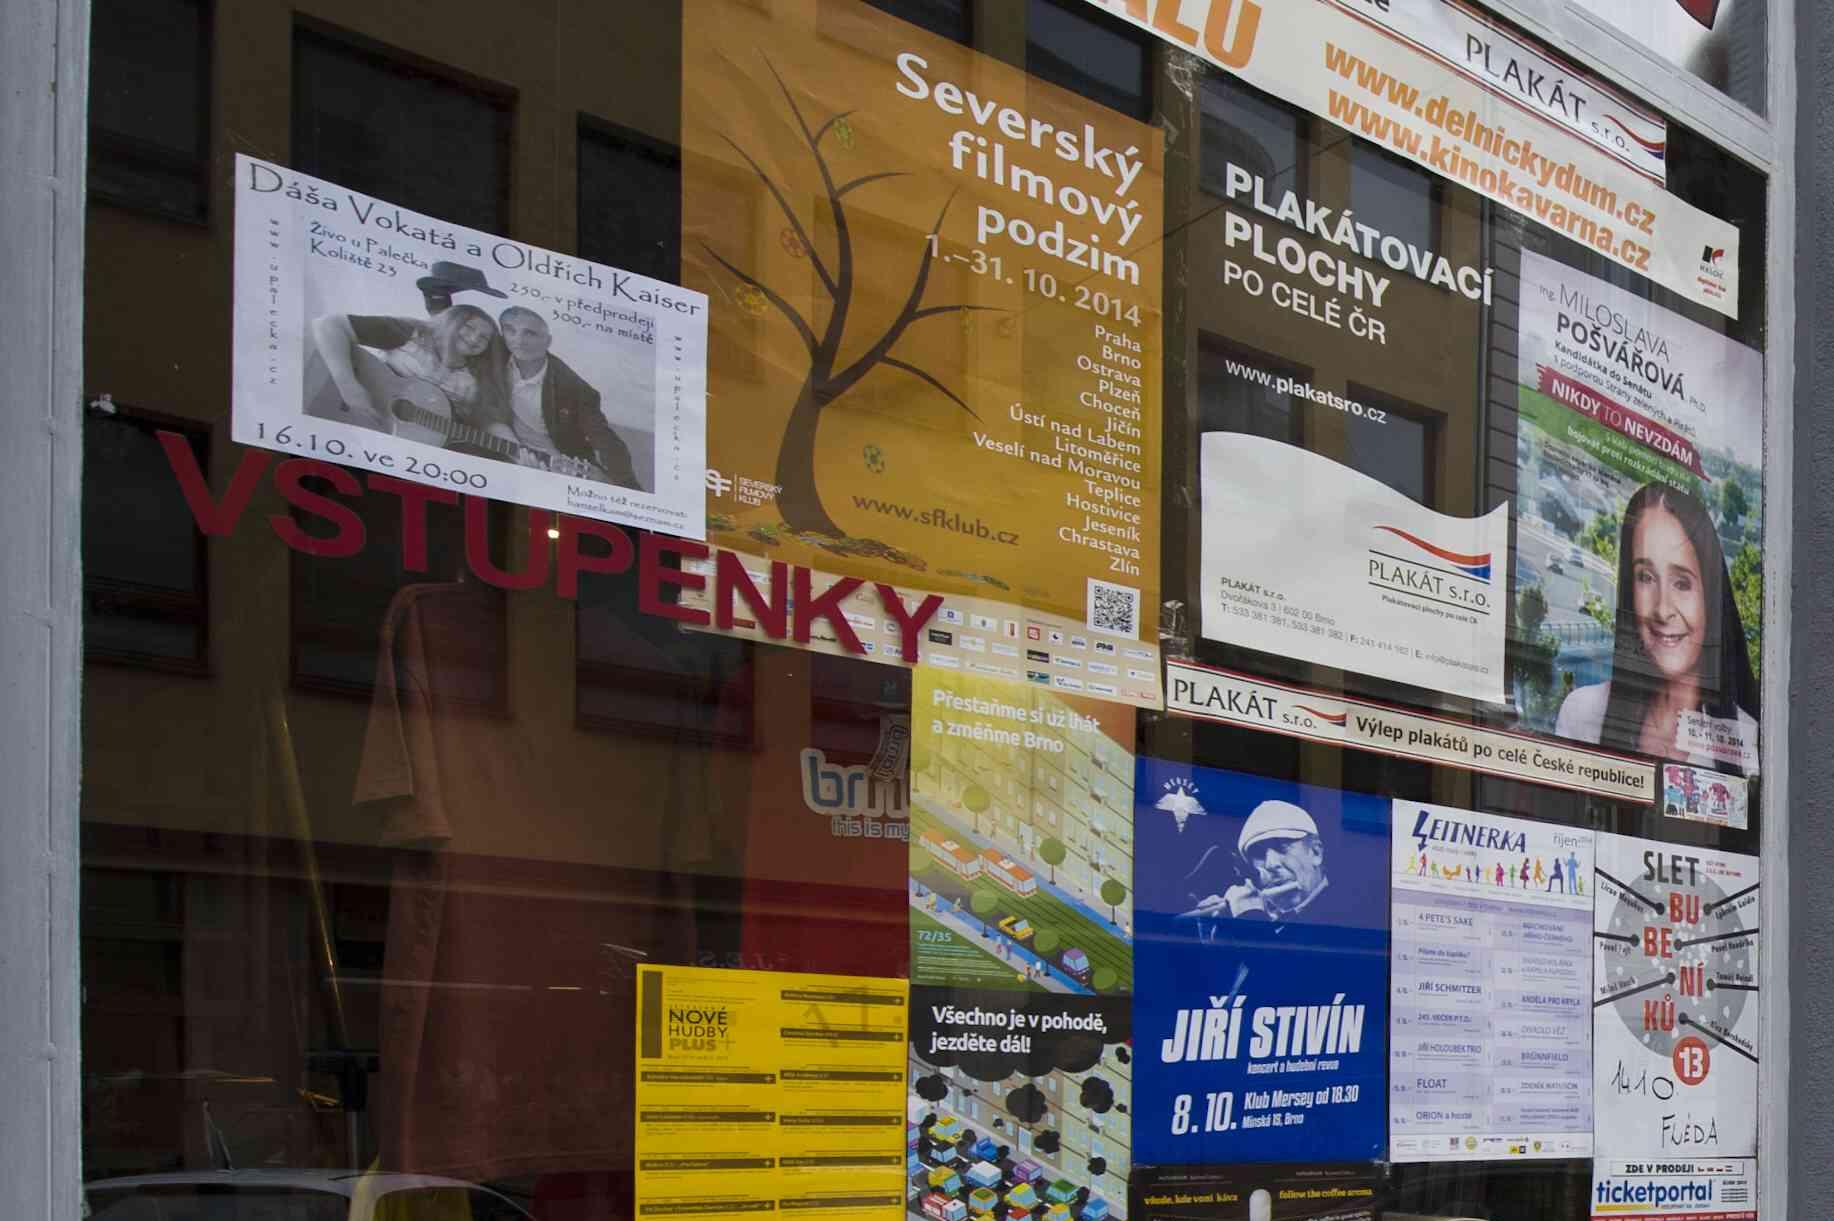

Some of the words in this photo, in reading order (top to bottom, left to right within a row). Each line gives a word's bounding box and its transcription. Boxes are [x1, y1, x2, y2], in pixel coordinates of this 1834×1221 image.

[1466, 32, 1587, 124] PLAKÁT
[1591, 119, 1631, 152] s.r.o.
[896, 52, 1143, 197] Severský
[1325, 41, 1655, 236] www.delnickydum.cz
[949, 130, 1142, 246] filmový
[1328, 87, 1652, 271] www.kinokavarna.cz
[249, 163, 337, 211] Dáša
[348, 195, 457, 250] Vokatá
[467, 243, 482, 258] a
[492, 243, 602, 290] Oldřich
[612, 272, 700, 317] Kaiser
[310, 222, 347, 245] Živo
[352, 238, 362, 249] u
[367, 238, 428, 270] Palečka
[977, 206, 1140, 285] podzim
[1226, 162, 1494, 305] PLAKÁTOVACÍ
[310, 239, 373, 270] Koliště
[377, 264, 398, 279] 23
[1225, 213, 1390, 308] PLOCHY
[566, 295, 656, 330] předprodeji
[1024, 267, 1066, 303] 10.
[1074, 286, 1141, 328] 2014
[1224, 261, 1264, 296] PO
[1272, 278, 1340, 325] CELÉ
[1348, 298, 1387, 344] ČR
[596, 322, 615, 334] na
[1095, 324, 1141, 352] Praha
[1559, 283, 1670, 363] MILOSLAVA
[1077, 355, 1141, 387] Ostrava
[1102, 345, 1141, 369] Brno
[1554, 341, 1608, 377] Kandidátka
[1609, 369, 1622, 382] do
[1623, 376, 1653, 400] Senátu
[1557, 312, 1685, 400] POŠVÁŘOVÁ
[1560, 359, 1605, 389] podporou
[1079, 392, 1141, 421] Choceň
[1099, 380, 1141, 403] Plzeň
[1226, 359, 1387, 425] www.plakatsro.cz
[1010, 402, 1045, 428] Ústí
[1051, 417, 1081, 438] nad
[1088, 428, 1141, 456] Labem
[1105, 418, 1141, 438] Jičín
[1551, 378, 1601, 416] NIKDY
[1602, 406, 1623, 428] TO
[1624, 417, 1694, 467] NEVZDÁM
[256, 422, 353, 458] 16.10.
[364, 449, 395, 468] ve
[406, 457, 488, 489] 20:00
[973, 431, 1024, 457] Veselí
[1030, 449, 1061, 468] nad
[1069, 458, 1140, 489] Moravou
[1056, 438, 1141, 473] Litoměřice
[1067, 494, 1140, 524] Hostivice
[1086, 480, 1141, 507] Teplice
[852, 495, 1019, 546] www.sfklub.cz
[1084, 517, 1140, 542] Jeseník
[156, 429, 944, 664] VSTUPENKY
[1059, 527, 1140, 559] Chrastava
[1110, 557, 1140, 576] Zlín
[1368, 558, 1444, 594] PLAKÁT
[1449, 584, 1492, 609] s.r.o.
[1221, 576, 1261, 594] PLAKÁT
[932, 689, 1026, 722] Přestaňme
[1030, 707, 1043, 723] si
[1046, 709, 1065, 728] už
[1068, 713, 1100, 734] lhát
[932, 721, 943, 735] a
[947, 724, 1021, 747] změňme
[1025, 732, 1064, 753] Brno
[1172, 678, 1278, 722] PLAKÁT
[1282, 712, 1318, 729] s.r.o.
[1356, 715, 1403, 744] Výlep
[1408, 727, 1469, 754] plakátů
[1473, 743, 1493, 761] po
[1498, 747, 1528, 766] celé
[1532, 748, 1575, 776] České
[1577, 764, 1645, 790] republice!
[1412, 810, 1527, 853] LEITNERKA
[1643, 851, 1699, 887] SLET
[1670, 892, 1700, 925] BU
[1644, 926, 1673, 958] BE
[1435, 983, 1481, 994] SCHMITZER
[1679, 961, 1704, 997] NÍ
[669, 1005, 728, 1026] NOVÉ
[932, 1006, 1007, 1027] Všechno
[1009, 1010, 1025, 1030] je
[1042, 1011, 1107, 1034] pohodě,
[1160, 995, 1247, 1064] JIŘÍ
[1249, 993, 1365, 1059] STIVÍN
[1644, 992, 1675, 1031] KŮ
[669, 1026, 728, 1039] HUDBY
[670, 1039, 717, 1052] PLUS
[929, 1032, 996, 1055] jezděte
[1000, 1033, 1031, 1053] dál!
[1679, 1048, 1704, 1078] 13
[1245, 1091, 1269, 1110] Klub
[1272, 1088, 1314, 1109] Mersey
[1316, 1087, 1329, 1105] od
[1332, 1085, 1359, 1105] 18.30
[1416, 1078, 1448, 1089] FLOAT
[1171, 1093, 1199, 1136] 8.
[1205, 1092, 1238, 1133] 10.
[1242, 1113, 1271, 1130] Minská
[1625, 1164, 1644, 1174] ZDE
[1656, 1164, 1694, 1174] PRODEJI
[1596, 1179, 1712, 1208] ticketportal
